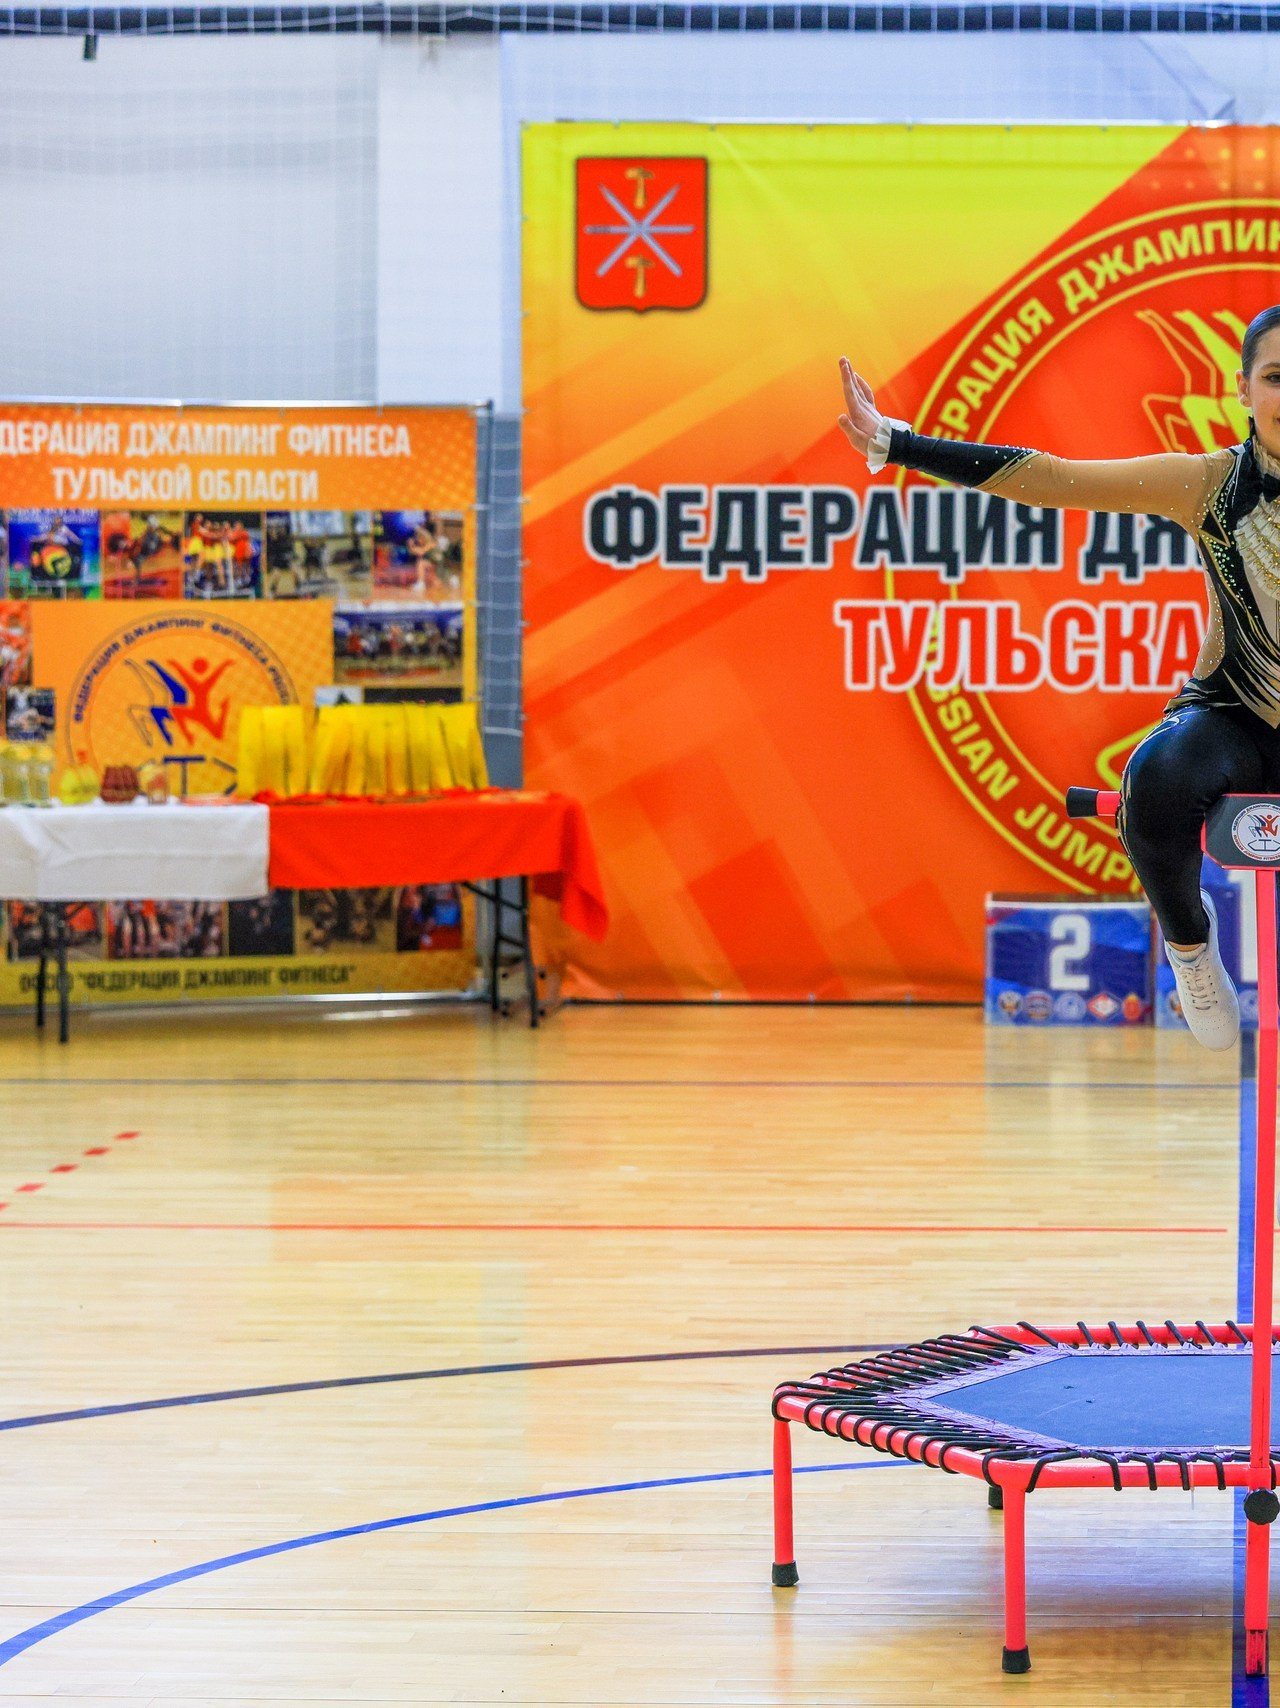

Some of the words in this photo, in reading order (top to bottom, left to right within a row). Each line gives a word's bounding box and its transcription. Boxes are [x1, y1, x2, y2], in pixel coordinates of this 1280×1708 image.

[931, 297, 1055, 443] РАЦИЯ
[125, 421, 282, 459] ДЖАМПИНГ
[288, 423, 411, 458] ФИТНЕСА
[52, 463, 193, 502] ТУЛЬСКОЙ
[199, 469, 319, 502] ОБЛАСТИ
[583, 484, 1063, 584] ФЕДЕРАЦИЯ
[834, 599, 1208, 694] ТУЛЬСКА
[1014, 802, 1140, 894] JUMP
[183, 967, 273, 990] ДЖАМПИНГ
[1050, 914, 1091, 991] 2
